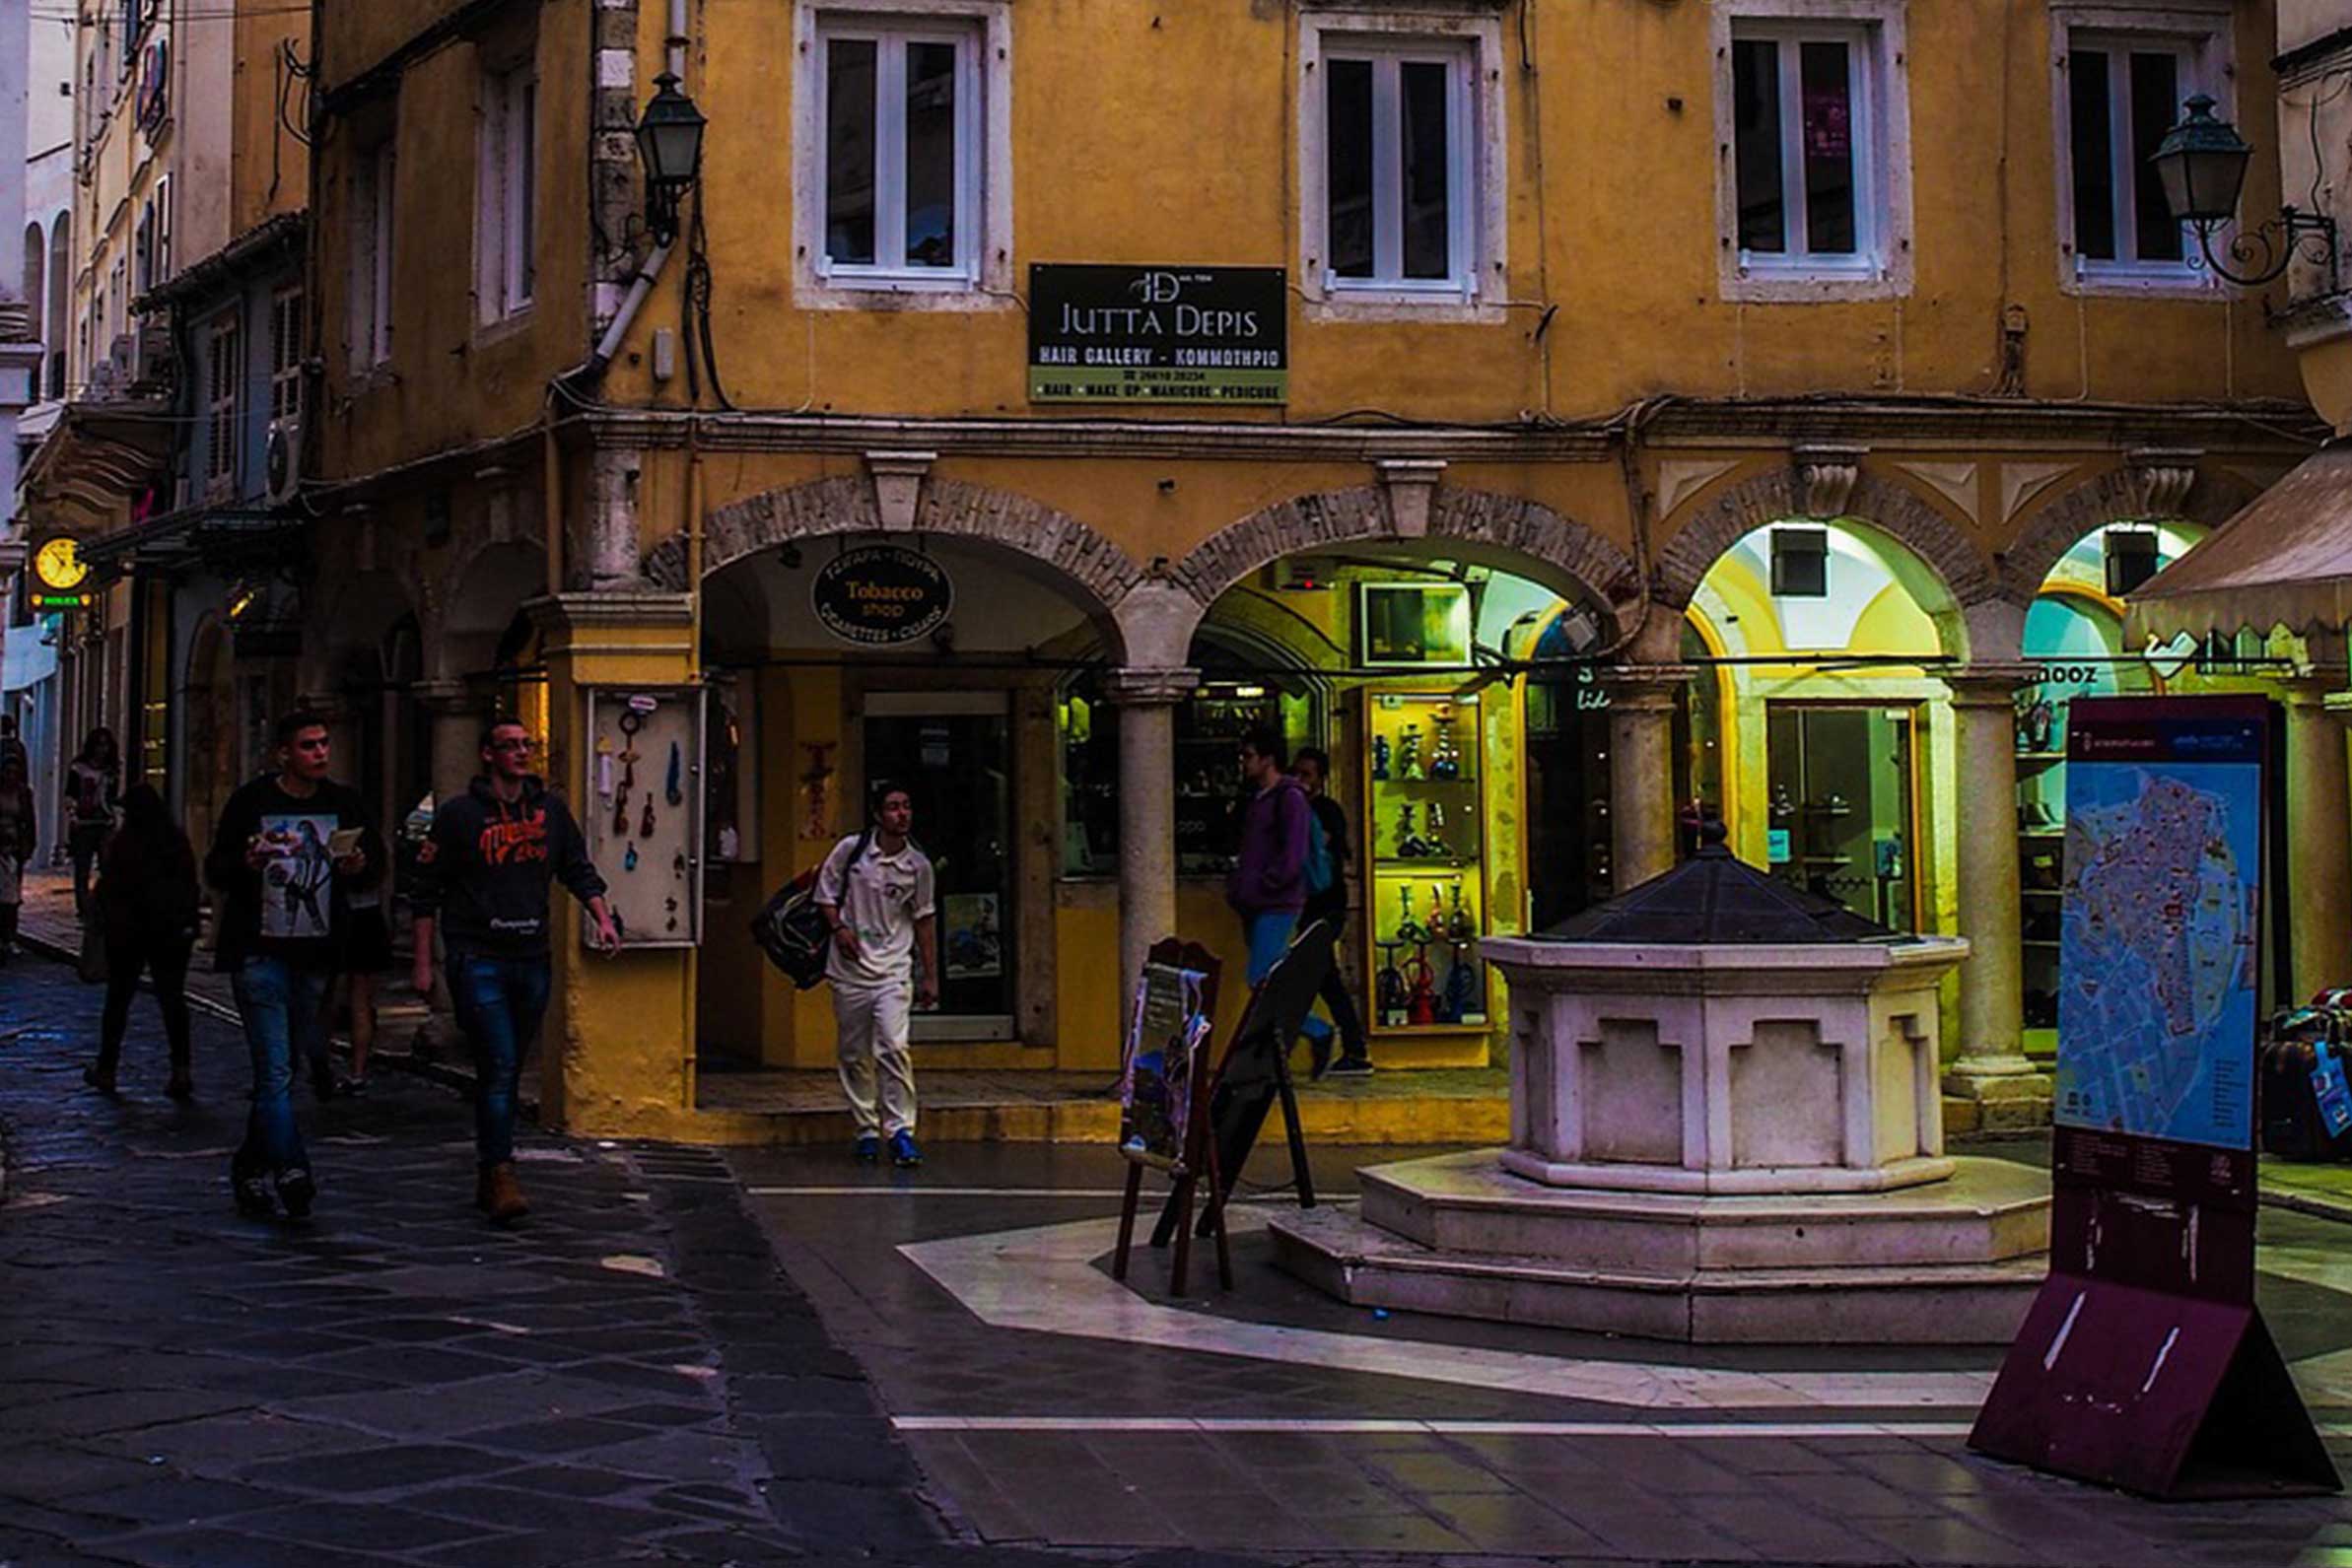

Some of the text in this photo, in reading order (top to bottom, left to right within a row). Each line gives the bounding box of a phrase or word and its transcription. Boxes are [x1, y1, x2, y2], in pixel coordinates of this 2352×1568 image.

[1039, 347, 1077, 364] HAIR
[1084, 347, 1152, 365] GALLERY
[845, 579, 925, 601] Tobacco
